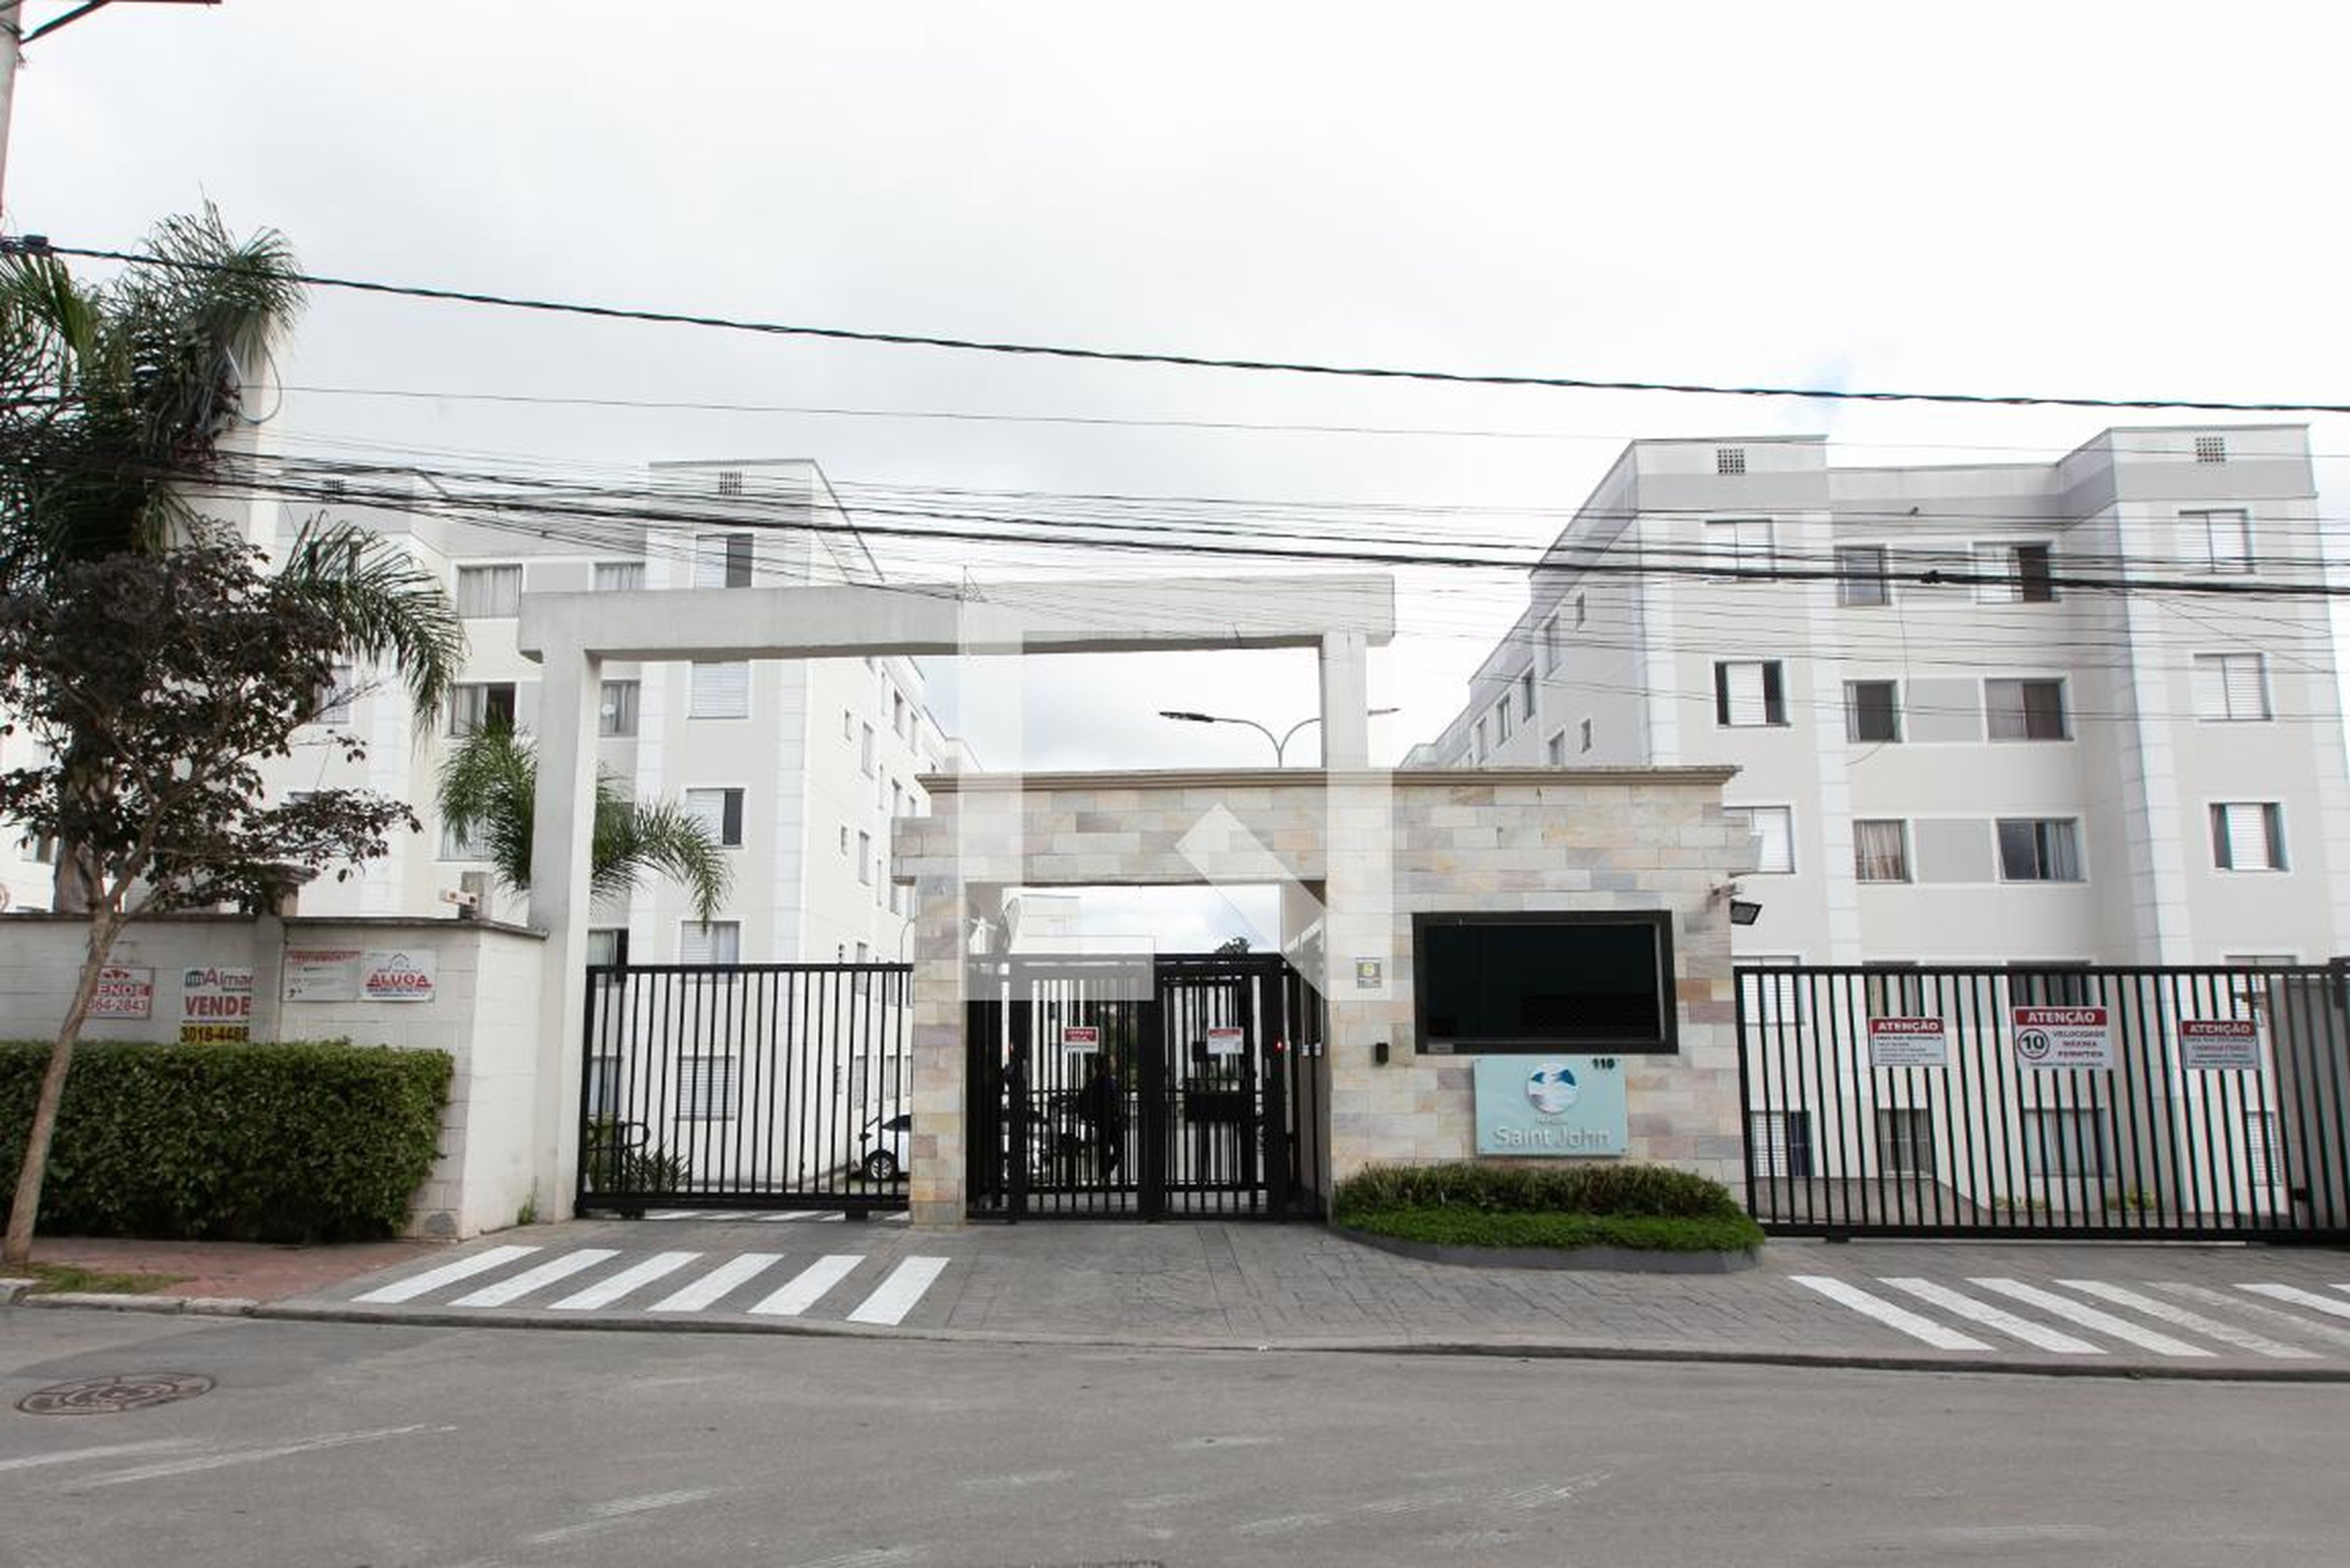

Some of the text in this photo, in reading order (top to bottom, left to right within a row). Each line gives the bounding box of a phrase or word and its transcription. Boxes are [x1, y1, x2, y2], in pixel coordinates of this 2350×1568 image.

[185, 995, 252, 1016] VENDE
[2027, 1010, 2096, 1025] ATENÇÃO
[1878, 1020, 1939, 1032] ATENÇÃO
[2189, 1023, 2251, 1035] ATENÇÃO
[2022, 1035, 2045, 1050] 10
[1592, 1058, 1615, 1069] 110
[1493, 1126, 1611, 1146] Saint John
